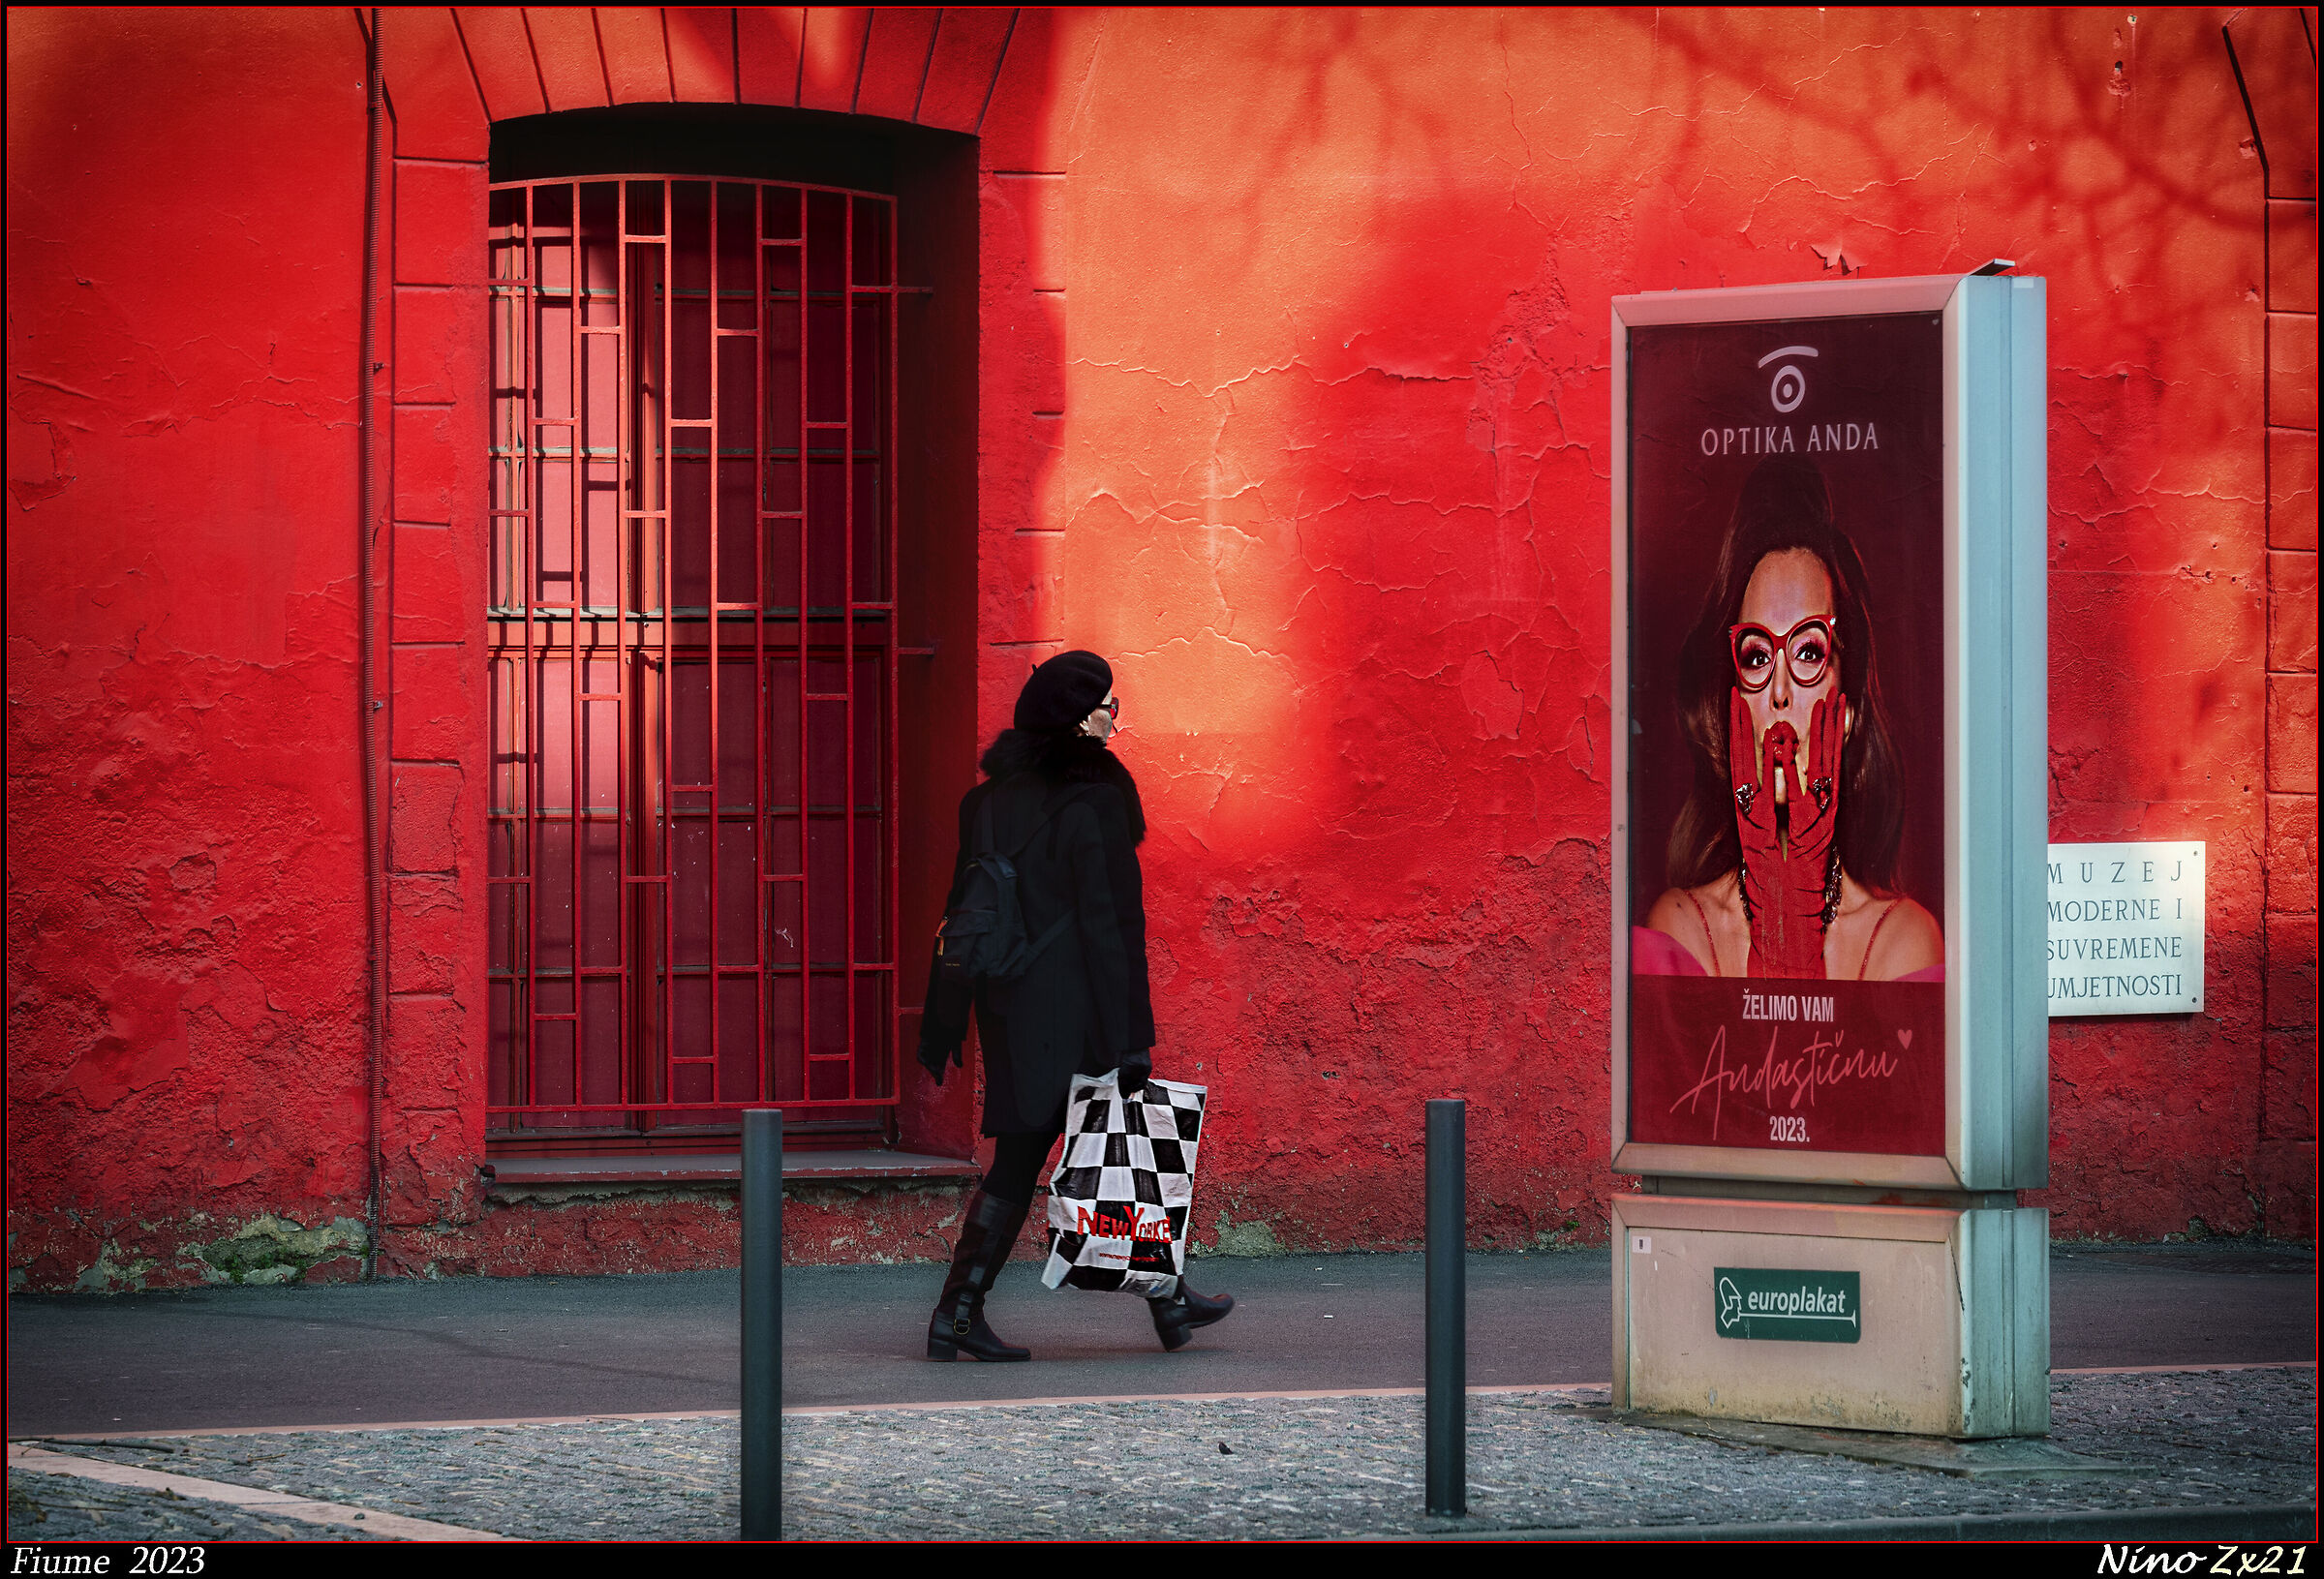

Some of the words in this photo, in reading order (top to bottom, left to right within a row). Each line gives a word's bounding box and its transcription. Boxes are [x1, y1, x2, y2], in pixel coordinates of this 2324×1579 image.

[1701, 425, 1795, 456] OPTIKA
[1807, 422, 1879, 452] ANDA
[2047, 898, 2160, 922] MODERNE
[2176, 898, 2182, 920] I
[2047, 936, 2182, 960] SUVREMENE
[1742, 987, 1797, 1021] ŽELIMO
[1801, 996, 1834, 1022] VAM
[1769, 1116, 1810, 1143] 2023.
[1748, 1286, 1846, 1316] europlakat
